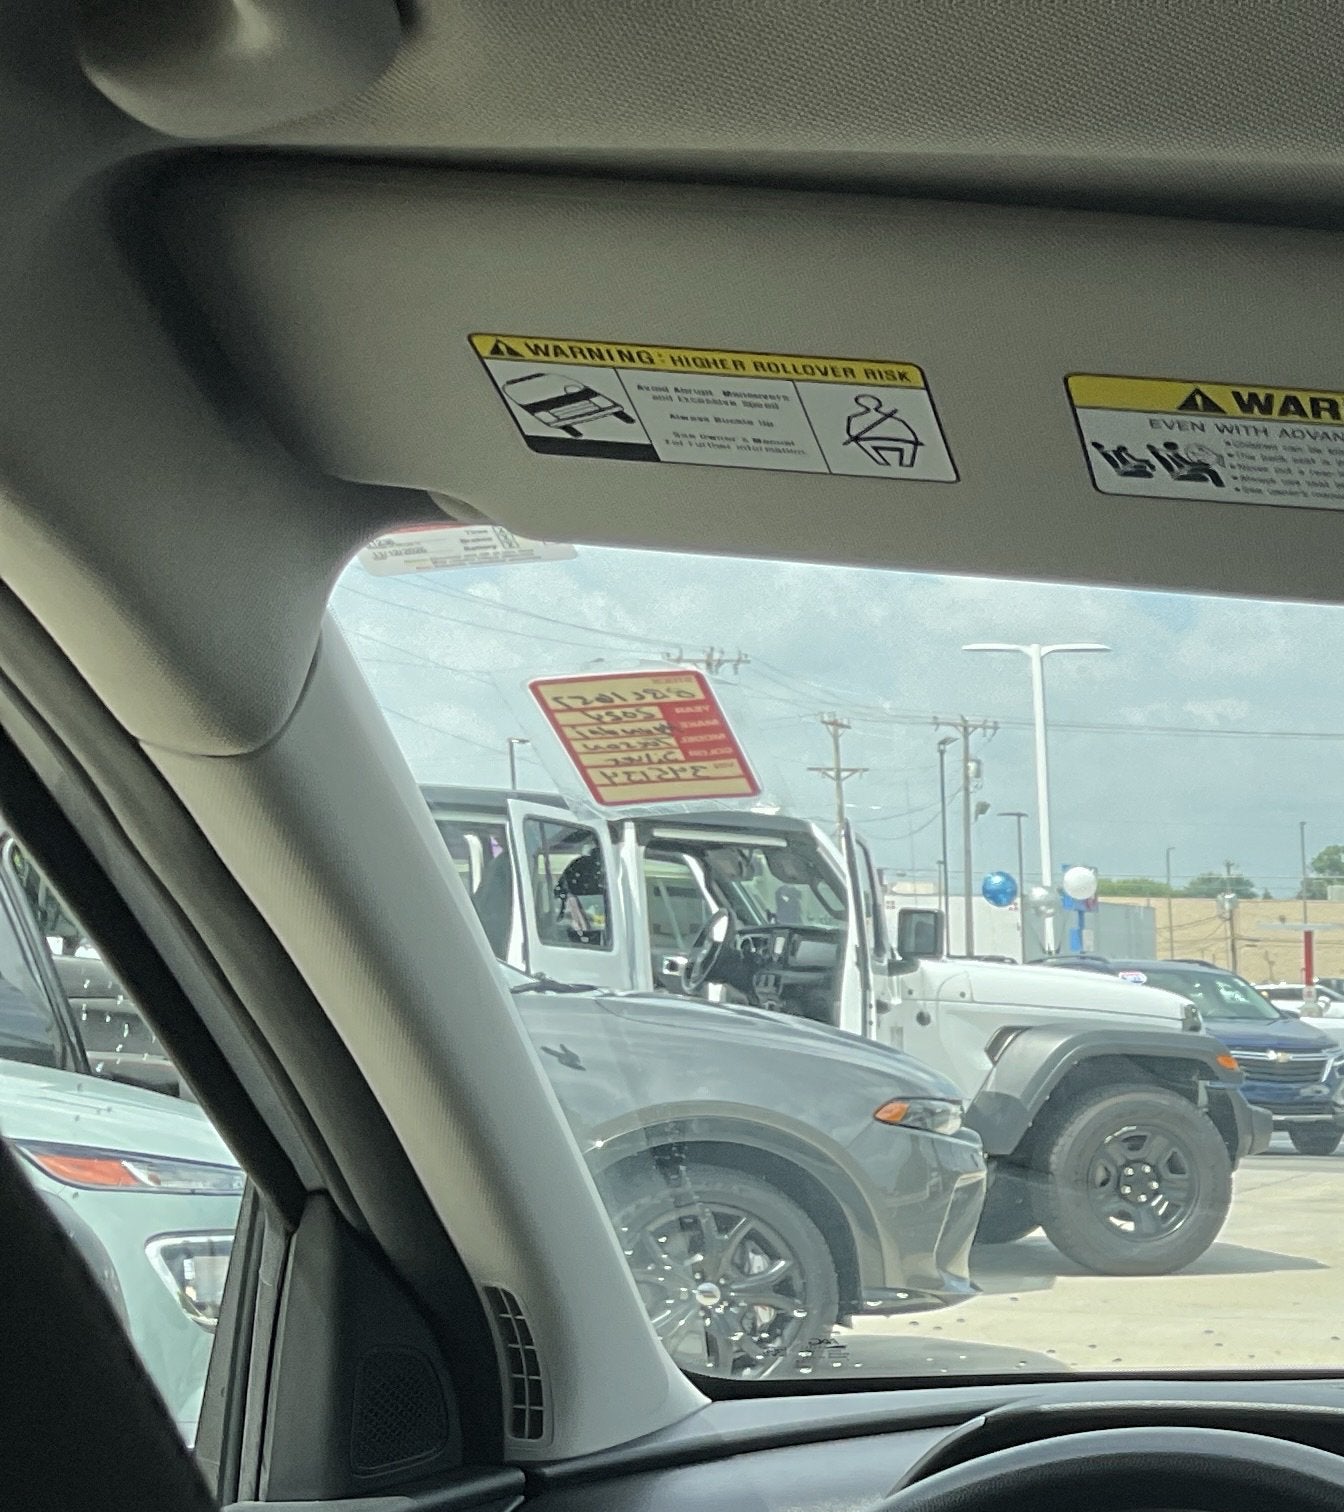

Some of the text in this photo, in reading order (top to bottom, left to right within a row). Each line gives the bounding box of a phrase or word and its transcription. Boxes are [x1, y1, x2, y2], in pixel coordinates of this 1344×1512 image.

[671, 354, 747, 373] HIGHER
[752, 360, 857, 380] ROLLOVER
[863, 367, 912, 384] RISK
[1149, 418, 1206, 433] EVEN
[1214, 423, 1268, 438] WITH
